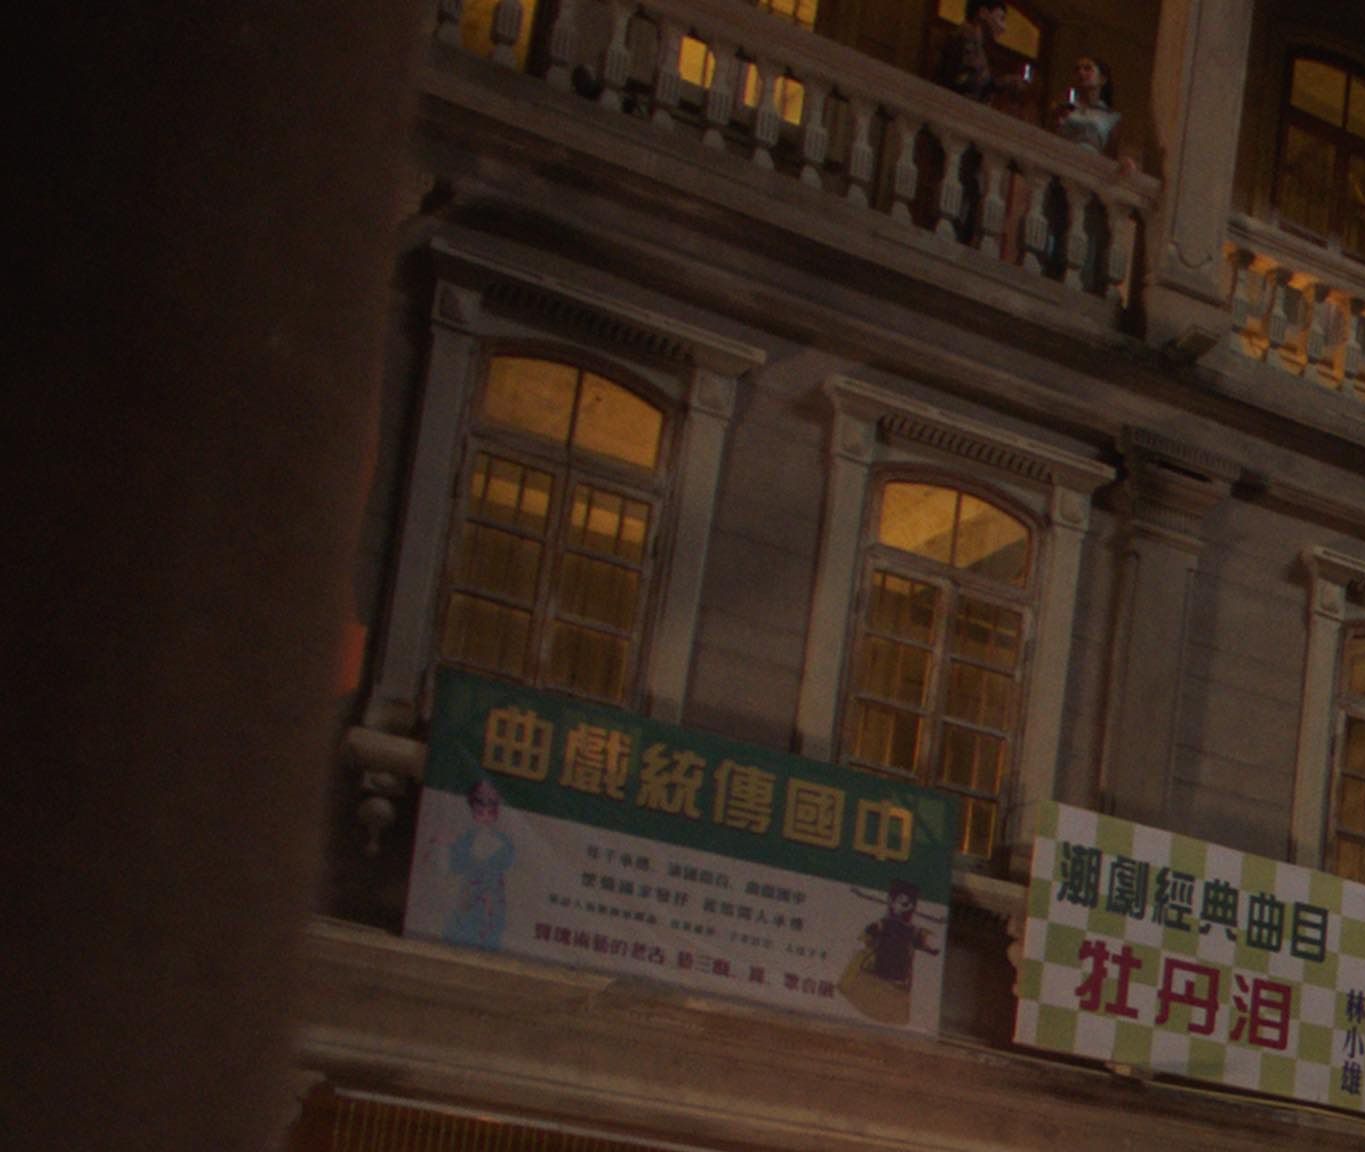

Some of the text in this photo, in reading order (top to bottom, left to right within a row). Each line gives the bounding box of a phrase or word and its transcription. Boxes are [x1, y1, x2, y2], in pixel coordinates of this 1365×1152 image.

[1056, 840, 1330, 965] 潮劇經典曲目
[1074, 938, 1294, 1053] 牡丹泪
